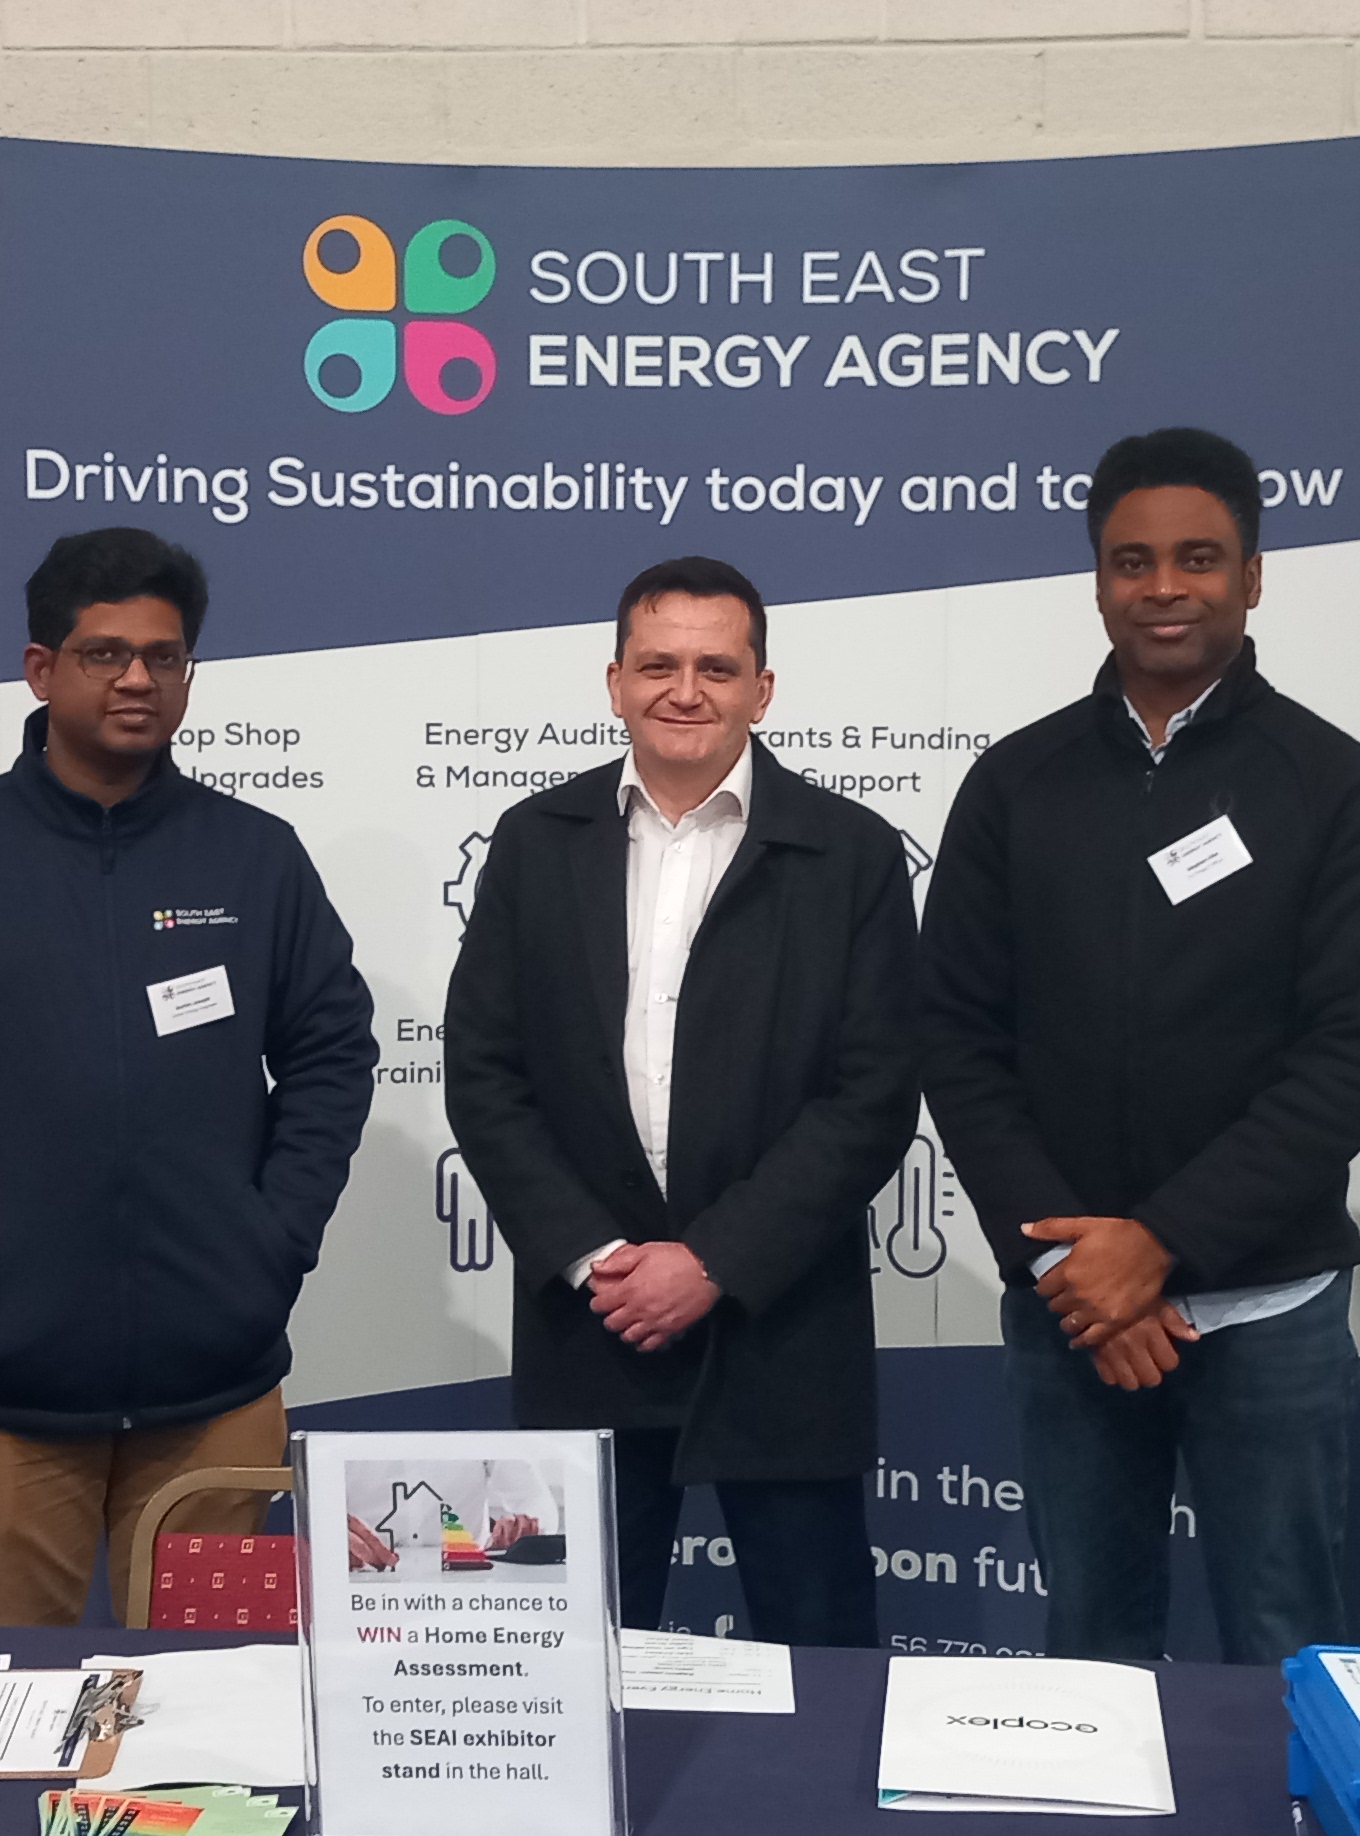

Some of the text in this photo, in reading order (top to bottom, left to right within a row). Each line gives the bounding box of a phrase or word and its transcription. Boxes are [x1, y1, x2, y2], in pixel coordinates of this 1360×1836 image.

[529, 248, 986, 305] SOUTH EAST
[529, 328, 1120, 388] ENERGY AGENCY
[25, 448, 1344, 526] Driving Sustainability today and toow
[224, 722, 300, 752] Shop
[425, 722, 633, 753] Energy Audits
[756, 727, 832, 748] rants
[841, 725, 861, 748] &
[416, 765, 436, 788] &
[397, 1018, 444, 1041] Ene
[377, 1060, 441, 1084] raini
[876, 1456, 1025, 1511] in the
[973, 1546, 1049, 1597] fut
[351, 1593, 568, 1611] Be in with a chance to
[357, 1626, 564, 1649] WIN a Home Energy
[393, 1659, 529, 1677] Assessment.
[362, 1696, 564, 1717] To enter, please visit
[946, 1714, 1099, 1734] ecoplex
[373, 1729, 557, 1747] the SEAI exhibitor
[382, 1762, 550, 1780] stand in the hall.
